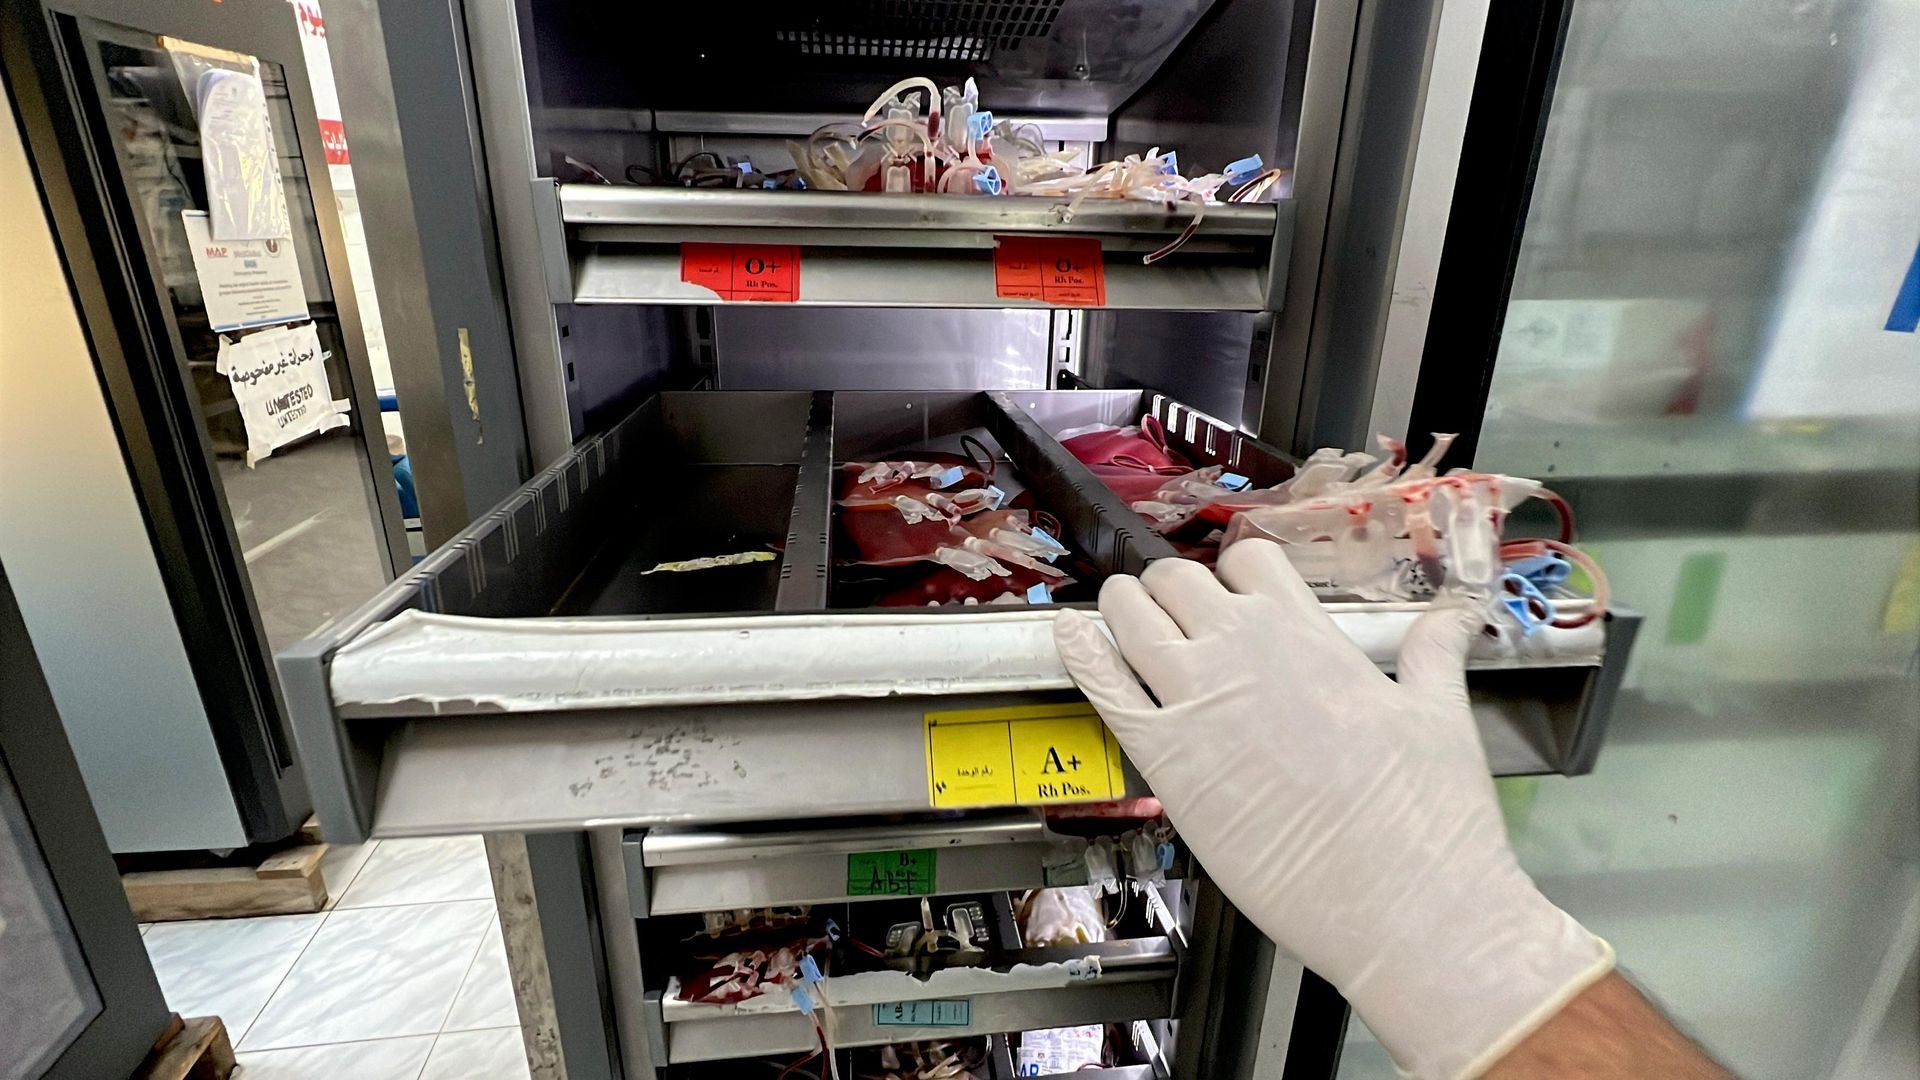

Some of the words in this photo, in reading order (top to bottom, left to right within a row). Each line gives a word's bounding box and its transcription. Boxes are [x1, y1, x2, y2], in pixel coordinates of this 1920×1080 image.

[206, 247, 228, 258] MAP
[744, 257, 783, 275] O+
[274, 352, 289, 376] غير
[1042, 745, 1082, 775] A+
[1038, 783, 1059, 798] Rh
[1062, 782, 1091, 796] Pos.
